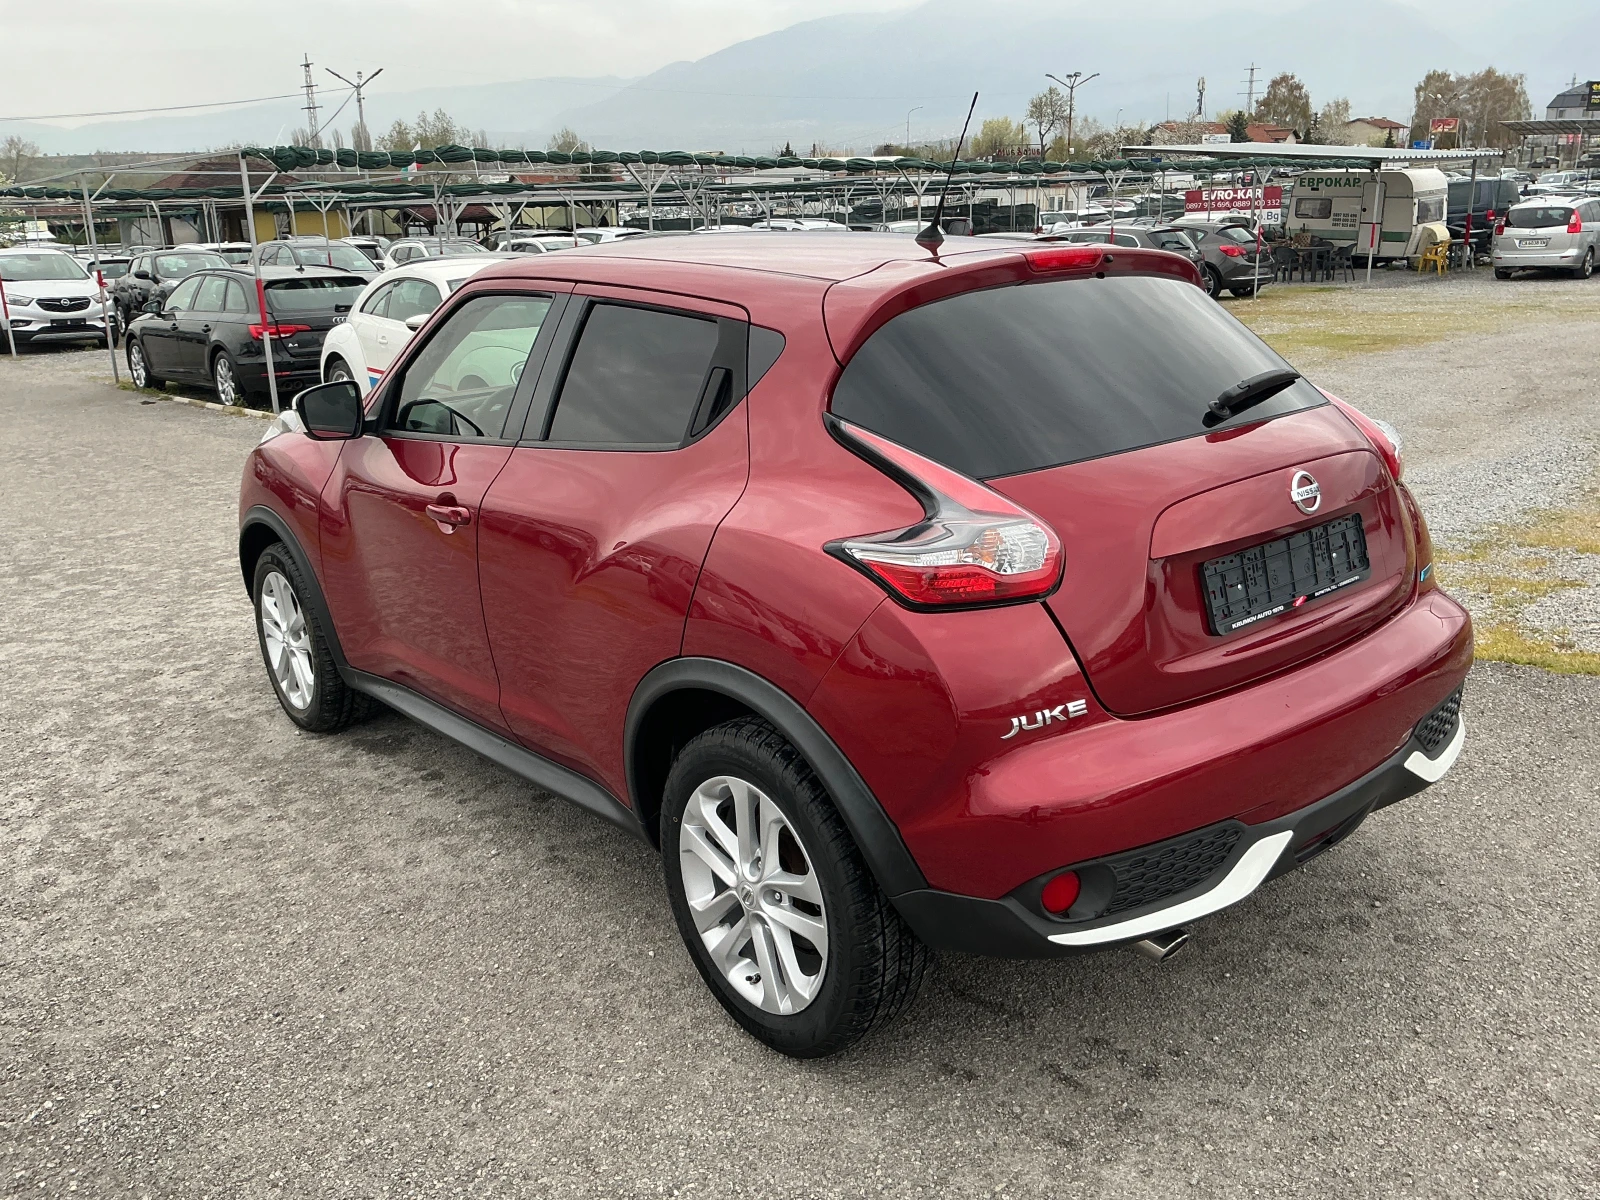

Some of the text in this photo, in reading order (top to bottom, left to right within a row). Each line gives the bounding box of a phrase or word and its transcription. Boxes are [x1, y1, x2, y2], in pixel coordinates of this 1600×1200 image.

[1299, 177, 1361, 188] ЕВРОКАР
[1202, 188, 1262, 200] EVRO-KAR
[1185, 202, 1202, 210] 0897
[1232, 200, 1250, 208] 0889
[1267, 198, 1280, 206] 332
[1297, 485, 1320, 498] NISSAN
[1231, 615, 1257, 629] KRUMOV
[1257, 609, 1272, 620] AUTO
[1000, 699, 1088, 739] JUKE
